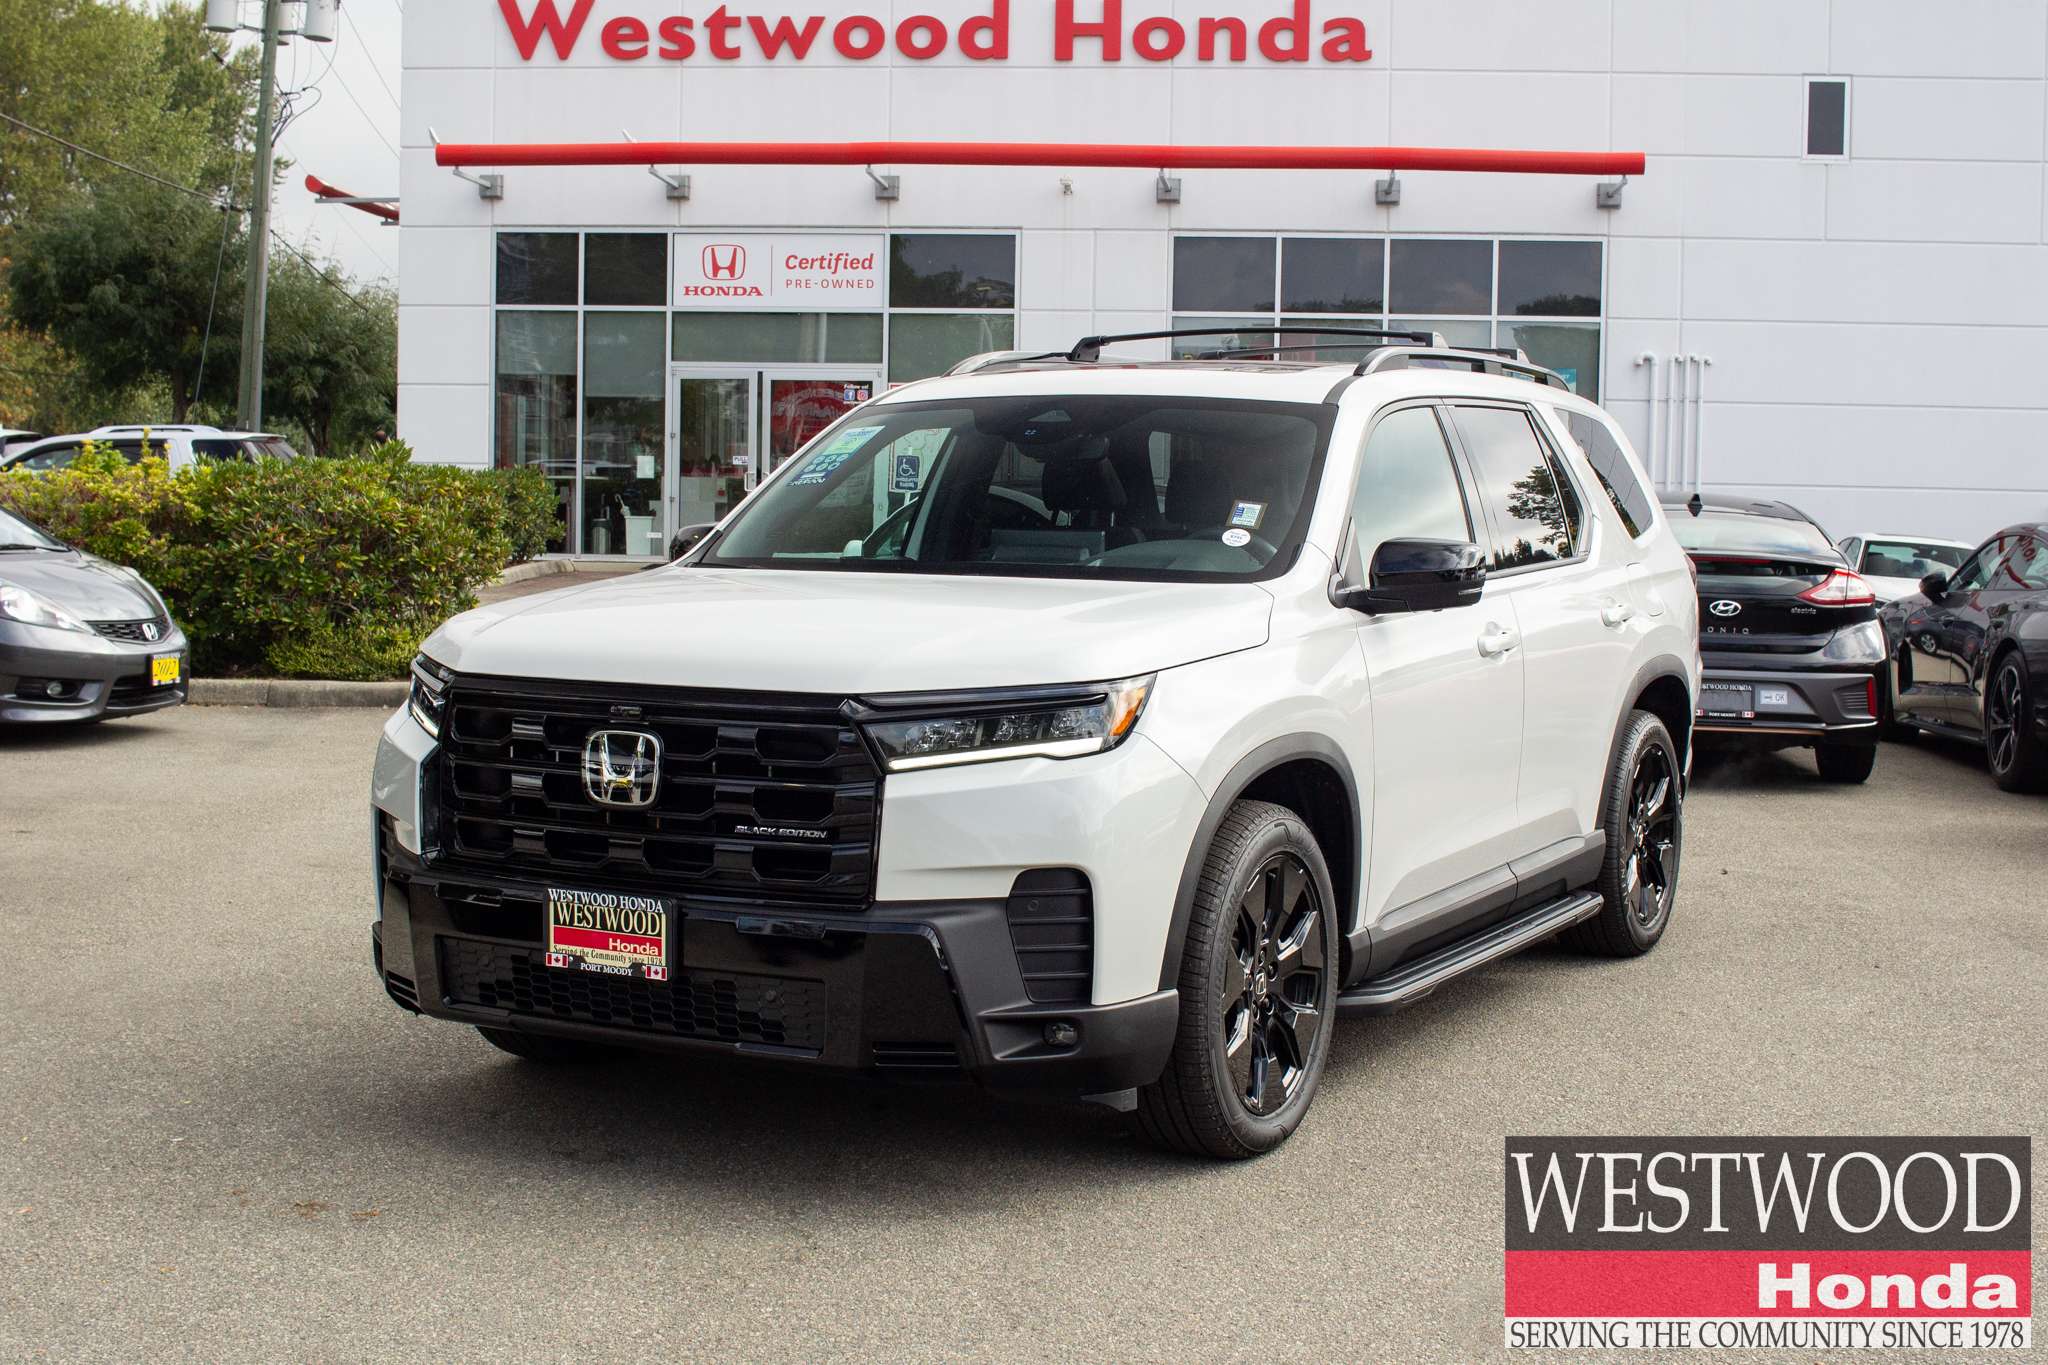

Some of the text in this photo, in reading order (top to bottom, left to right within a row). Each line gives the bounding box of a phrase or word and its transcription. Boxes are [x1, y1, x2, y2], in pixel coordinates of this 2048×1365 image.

[497, 0, 1373, 62] Westwood Honda
[785, 253, 874, 275] Certified
[786, 279, 875, 289] PRE-OWNED
[683, 286, 763, 297] HONDA
[1707, 626, 1749, 635] ONIQ
[735, 825, 827, 838] BLACK EDITION
[548, 888, 664, 913] WESTWOOD HONDA
[557, 902, 660, 935] WESTWOOD
[608, 938, 659, 956] Honda
[591, 950, 626, 963] Community
[580, 962, 633, 976] PORT MOODY
